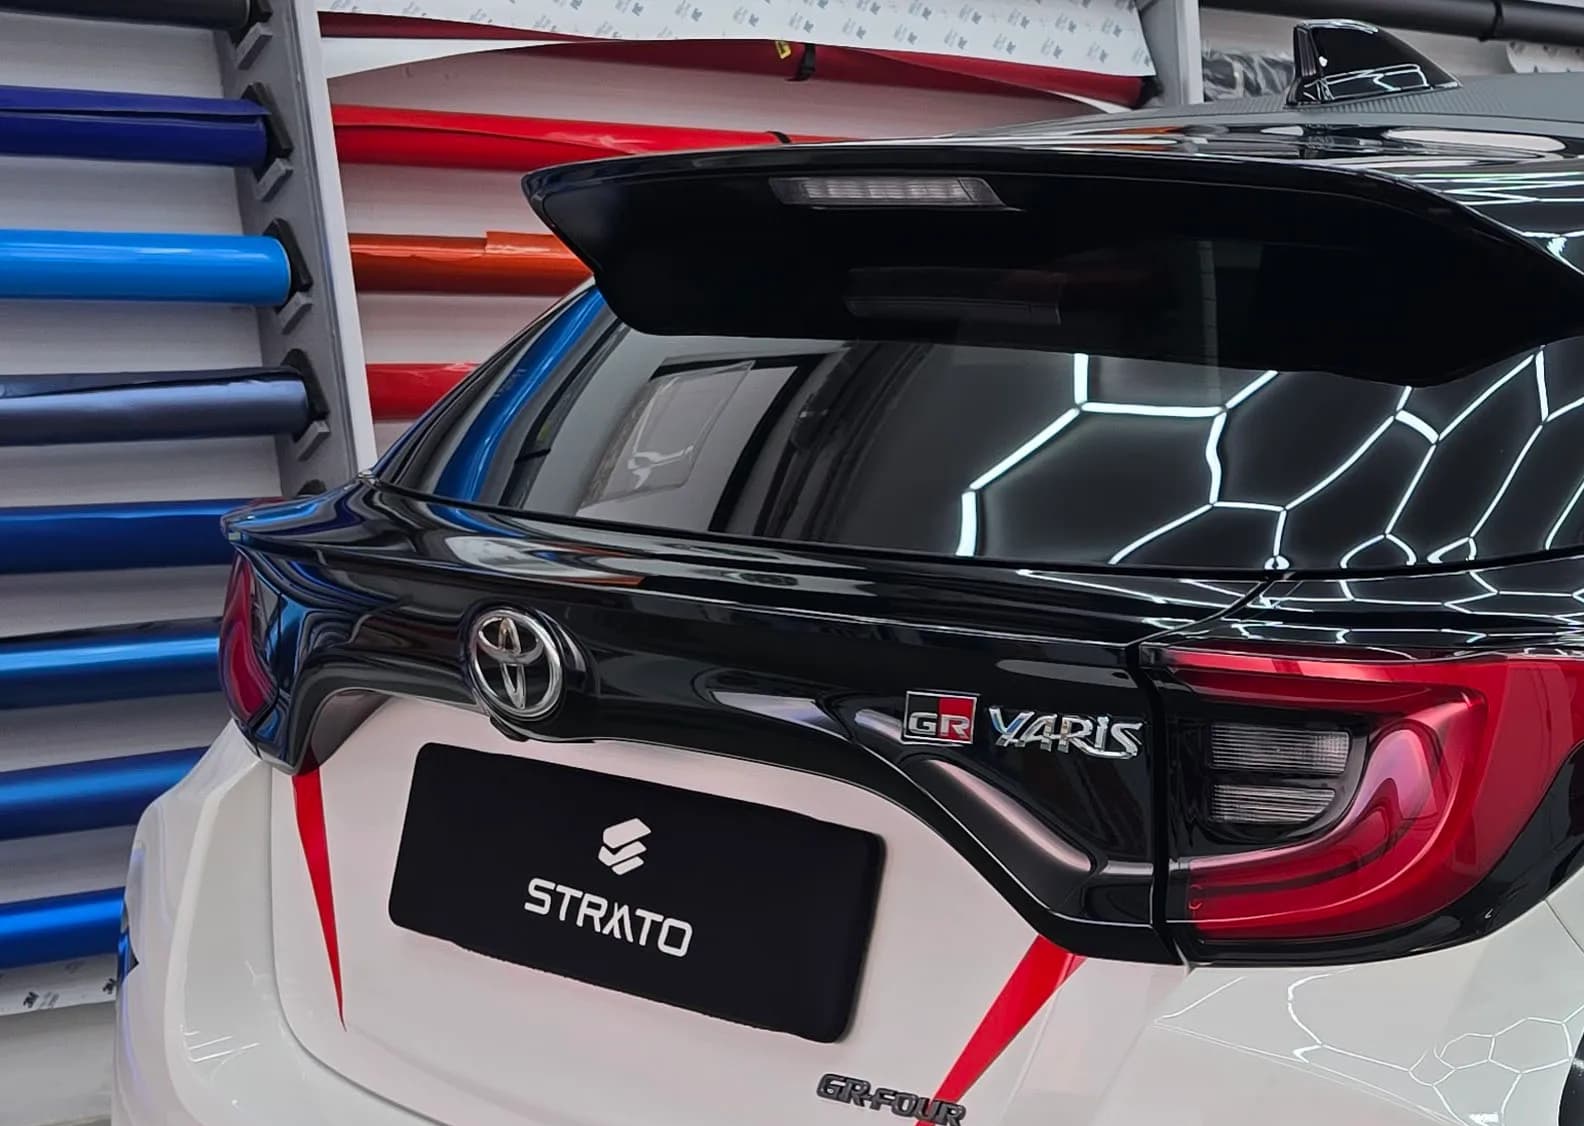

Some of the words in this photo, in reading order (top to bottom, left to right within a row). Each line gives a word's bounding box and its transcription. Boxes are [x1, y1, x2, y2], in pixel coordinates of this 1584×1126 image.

[908, 712, 972, 742] GR
[988, 705, 1143, 760] YARIS
[524, 877, 693, 957] STRATO
